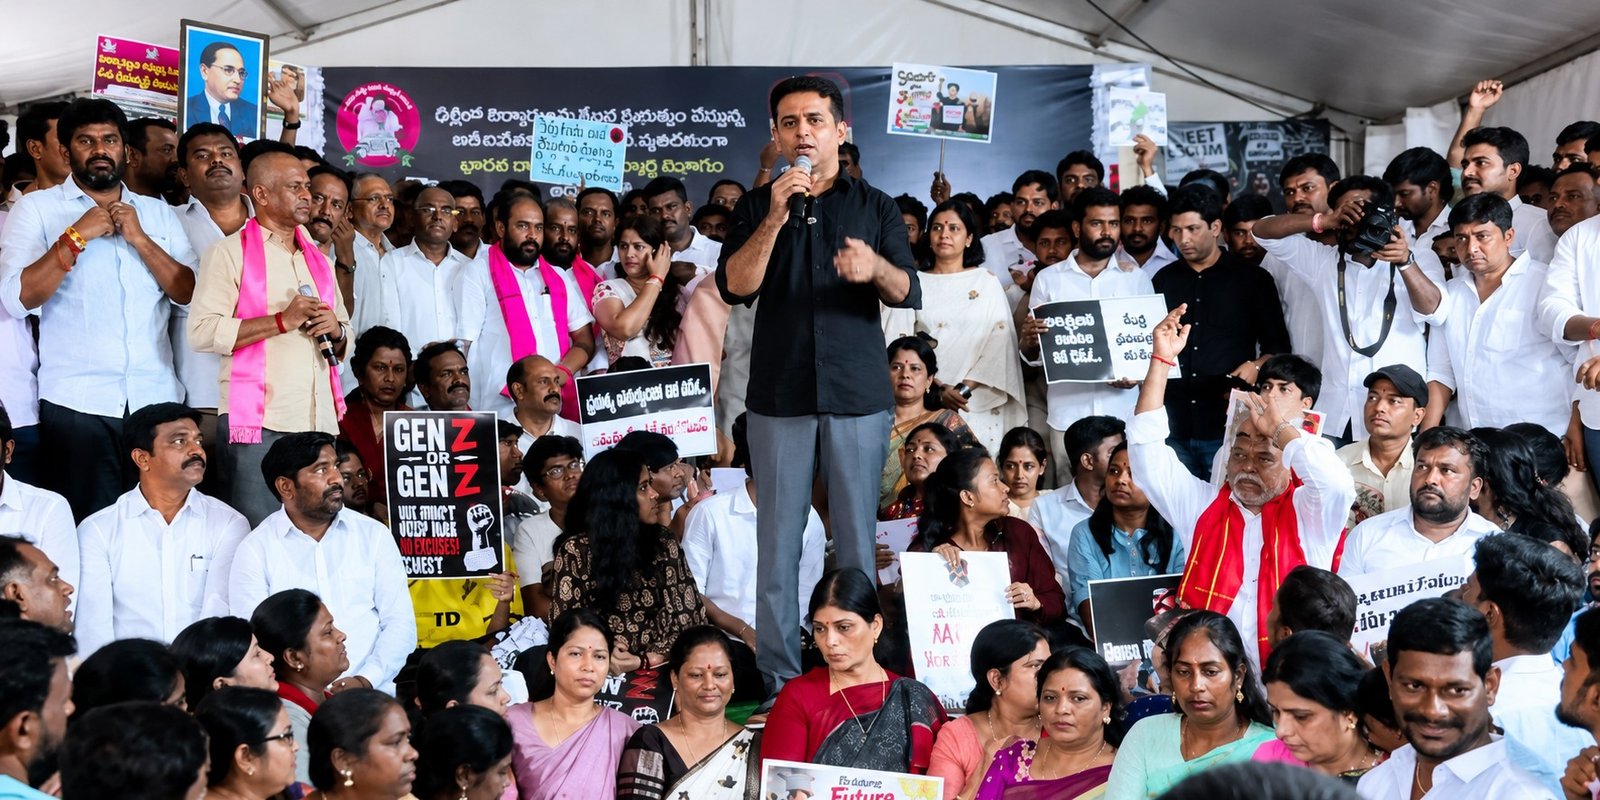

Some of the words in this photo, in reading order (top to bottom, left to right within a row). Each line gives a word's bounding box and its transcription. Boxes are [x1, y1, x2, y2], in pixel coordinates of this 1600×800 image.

[393, 418, 446, 452] GEN
[451, 418, 478, 452] Z
[426, 451, 451, 464] OR
[396, 464, 449, 498] GEN
[454, 464, 481, 498] Z
[414, 537, 460, 555] EXCUSES!
[433, 611, 461, 627] TD
